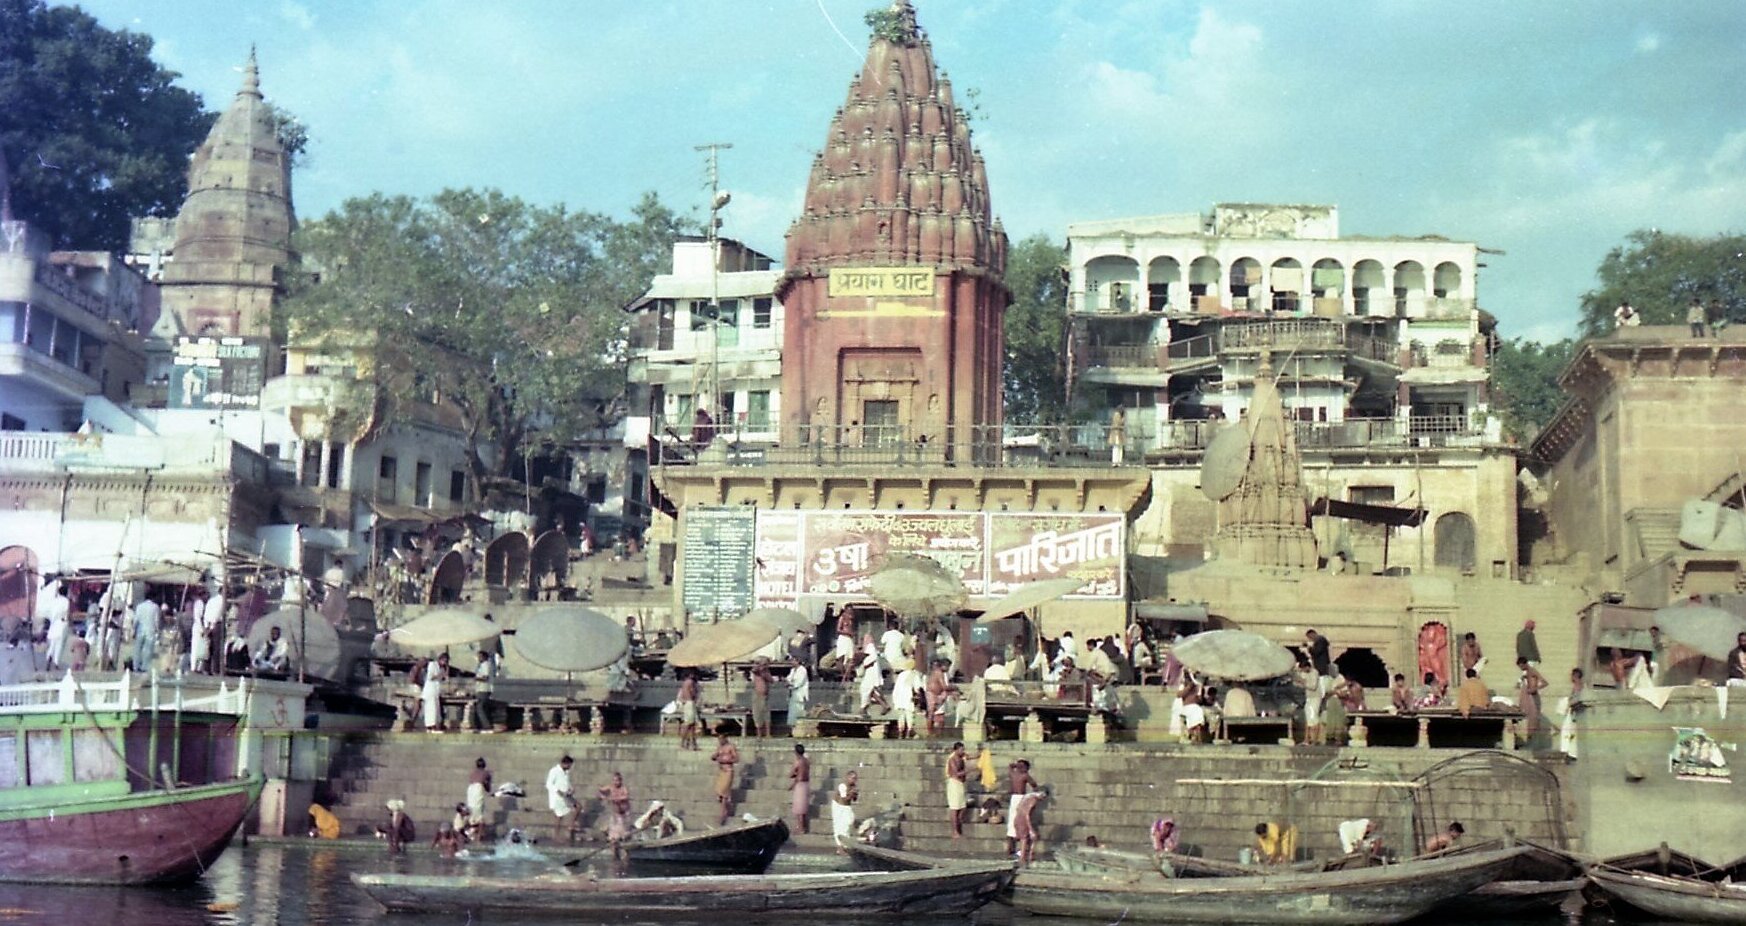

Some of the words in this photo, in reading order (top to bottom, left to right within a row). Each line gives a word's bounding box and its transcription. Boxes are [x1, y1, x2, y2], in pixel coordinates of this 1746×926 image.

[837, 272, 886, 292] प्रयाग
[892, 272, 930, 291] घाट
[813, 542, 870, 575] उषा
[994, 520, 1121, 576] पारिजात
[758, 581, 796, 596] HOTEL
